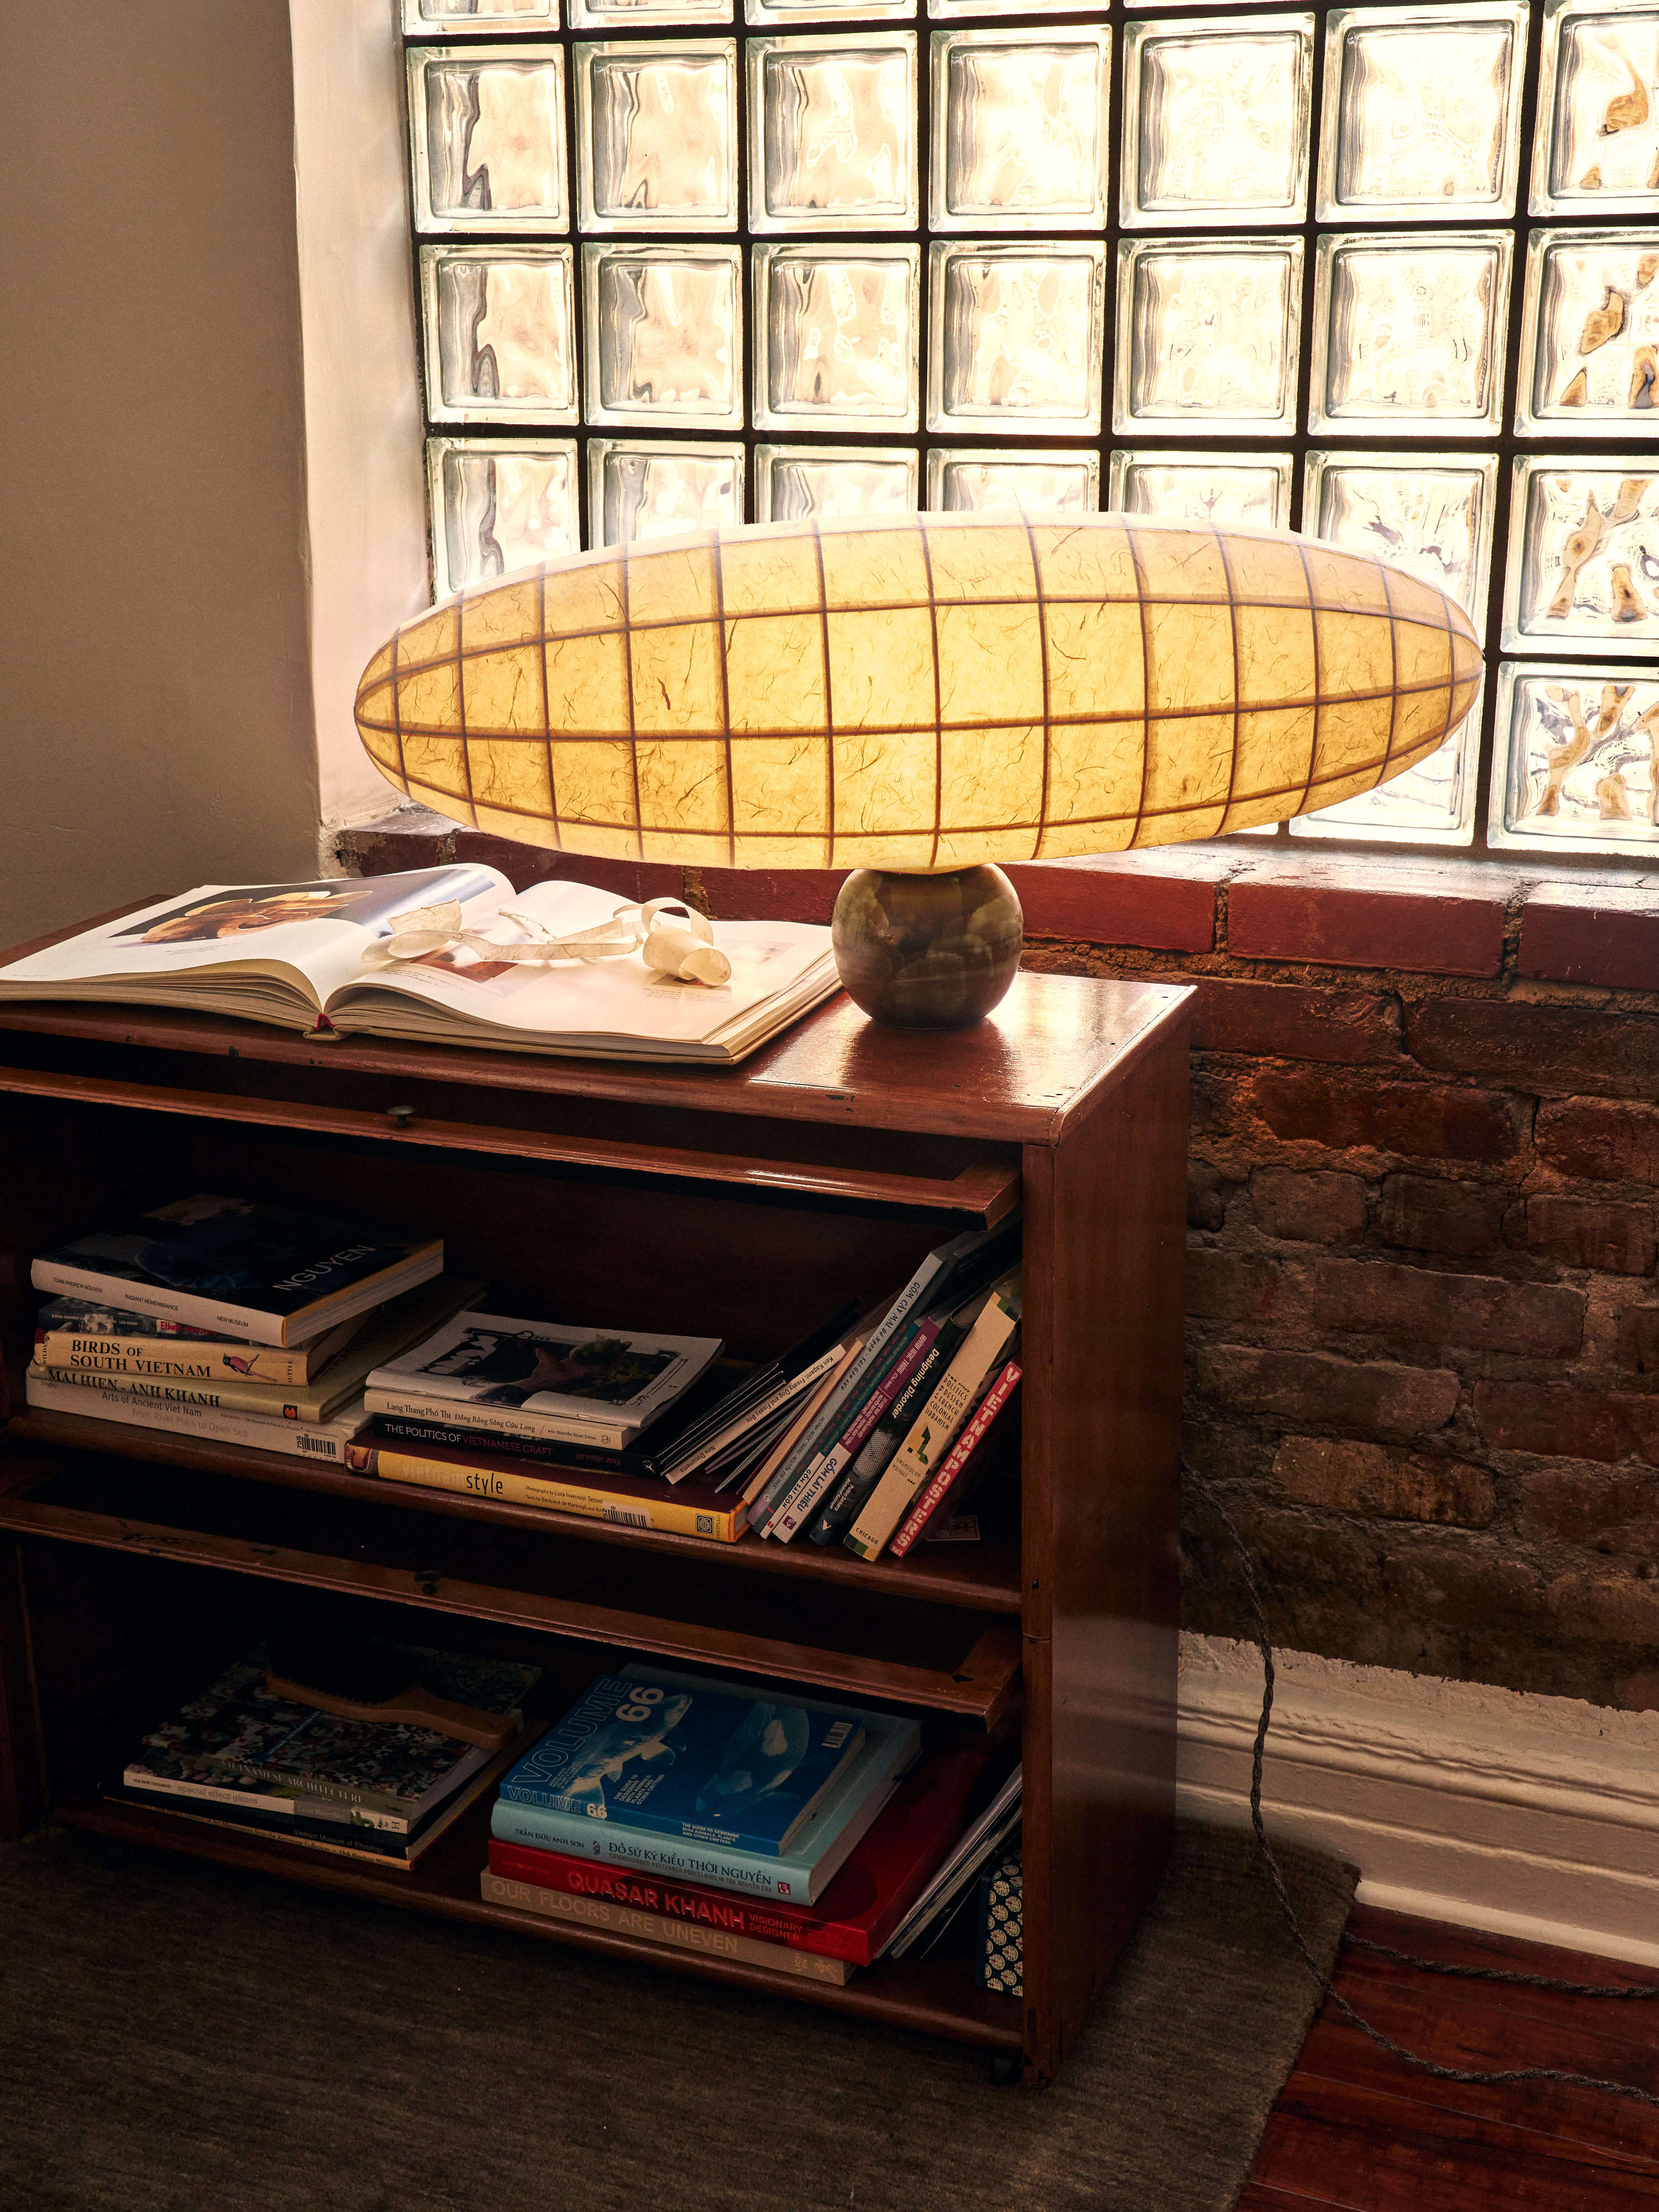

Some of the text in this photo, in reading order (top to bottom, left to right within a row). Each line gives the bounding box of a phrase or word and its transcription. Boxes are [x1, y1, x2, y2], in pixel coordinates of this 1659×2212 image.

[272, 1245, 376, 1291] NGUYEN
[65, 1280, 84, 1288] ANDREW
[85, 1284, 102, 1293] NGUYEN
[905, 1281, 923, 1301] GỐM
[125, 1294, 178, 1311] RADIANT REMEMBRANCE
[228, 1318, 248, 1327] MUSEUM
[885, 1312, 899, 1328] MAI
[72, 1339, 143, 1357] BIRDS OF
[913, 1333, 928, 1350] HUỲNH
[857, 1356, 867, 1367] Sài
[904, 1346, 917, 1360] NGỌC
[71, 1355, 211, 1377] SOUTH VIETNAM
[848, 1366, 859, 1379] Gòn
[48, 1369, 220, 1407] MAI HIEN ANH KHANH
[745, 1355, 833, 1423] Ken Kagami: Freaky Dog and Freaky Boy
[889, 1347, 941, 1420] Designing Disorder
[943, 1377, 968, 1400] POLITICS
[948, 1374, 957, 1383] THE
[102, 1391, 202, 1417] Arts of Ancient Viet Nam
[938, 1396, 959, 1416] FRENCH
[943, 1390, 964, 1408] DESIGN
[132, 1408, 248, 1437] From River Plain to Open Sea
[387, 1402, 403, 1413] Lang
[404, 1405, 424, 1417] Thang
[441, 1410, 451, 1420] Thị
[520, 1423, 535, 1433] Long
[925, 1407, 950, 1431] URBANISM
[930, 1401, 954, 1423] COLONIAL
[385, 1423, 553, 1456] THE POLITICS OF VIETNAMESE CRAFT
[576, 1452, 622, 1466] jennifer way
[679, 1444, 716, 1473] New Documents
[896, 1458, 920, 1478] GWENDOLYN
[403, 1460, 503, 1495] vietnam style
[892, 1463, 908, 1478] WRIGHT
[525, 1485, 549, 1494] Photographs
[566, 1493, 587, 1501] Invernizzi
[781, 1468, 813, 1509] GỐM SÀI GÒN
[796, 1457, 841, 1513] GỐM LÁI THIÊU
[837, 1477, 851, 1496] Richard
[568, 1502, 587, 1510] Hartingh
[833, 1483, 854, 1512] Pablo Sendra
[855, 1527, 878, 1545] CHICAGO
[511, 1678, 664, 1782] VOLUME 66
[178, 1786, 258, 1804] special effect glazes
[288, 1777, 362, 1803] ARCHITECTURE
[619, 1780, 640, 1801] DESIGNING
[620, 1780, 633, 1791] GUIDE
[625, 1775, 653, 1802] WITH ANIMALS,
[630, 1780, 653, 1803] PLANTS AND
[637, 1775, 665, 1804] OTHER CRITTERS
[507, 1785, 607, 1819] VOLUME 66
[294, 1829, 318, 1839] Vietnam
[320, 1834, 345, 1845] Museum
[354, 1841, 384, 1854] Ethnology
[714, 1829, 739, 1838] DESIGNING
[352, 1853, 374, 1863] Rinehart
[375, 1858, 397, 1868] Winston
[608, 1841, 626, 1854] ĐỒ
[628, 1845, 642, 1857] SỨ
[644, 1848, 658, 1861] KÝ
[688, 1858, 717, 1874] THỜI
[721, 1866, 772, 1886] NGUYỄN
[609, 1853, 651, 1867] COMMISSIONED
[651, 1862, 683, 1874] PATTERNED
[684, 1868, 717, 1881] PORCELAINS
[761, 1884, 772, 1893] ERA
[567, 1870, 744, 1929] QUASAR KHANH
[492, 1881, 737, 1953] OUR FLOORS ARE UNEVEN
[749, 1913, 802, 1932] VISIONARY
[749, 1923, 799, 1941] DESIGNER
